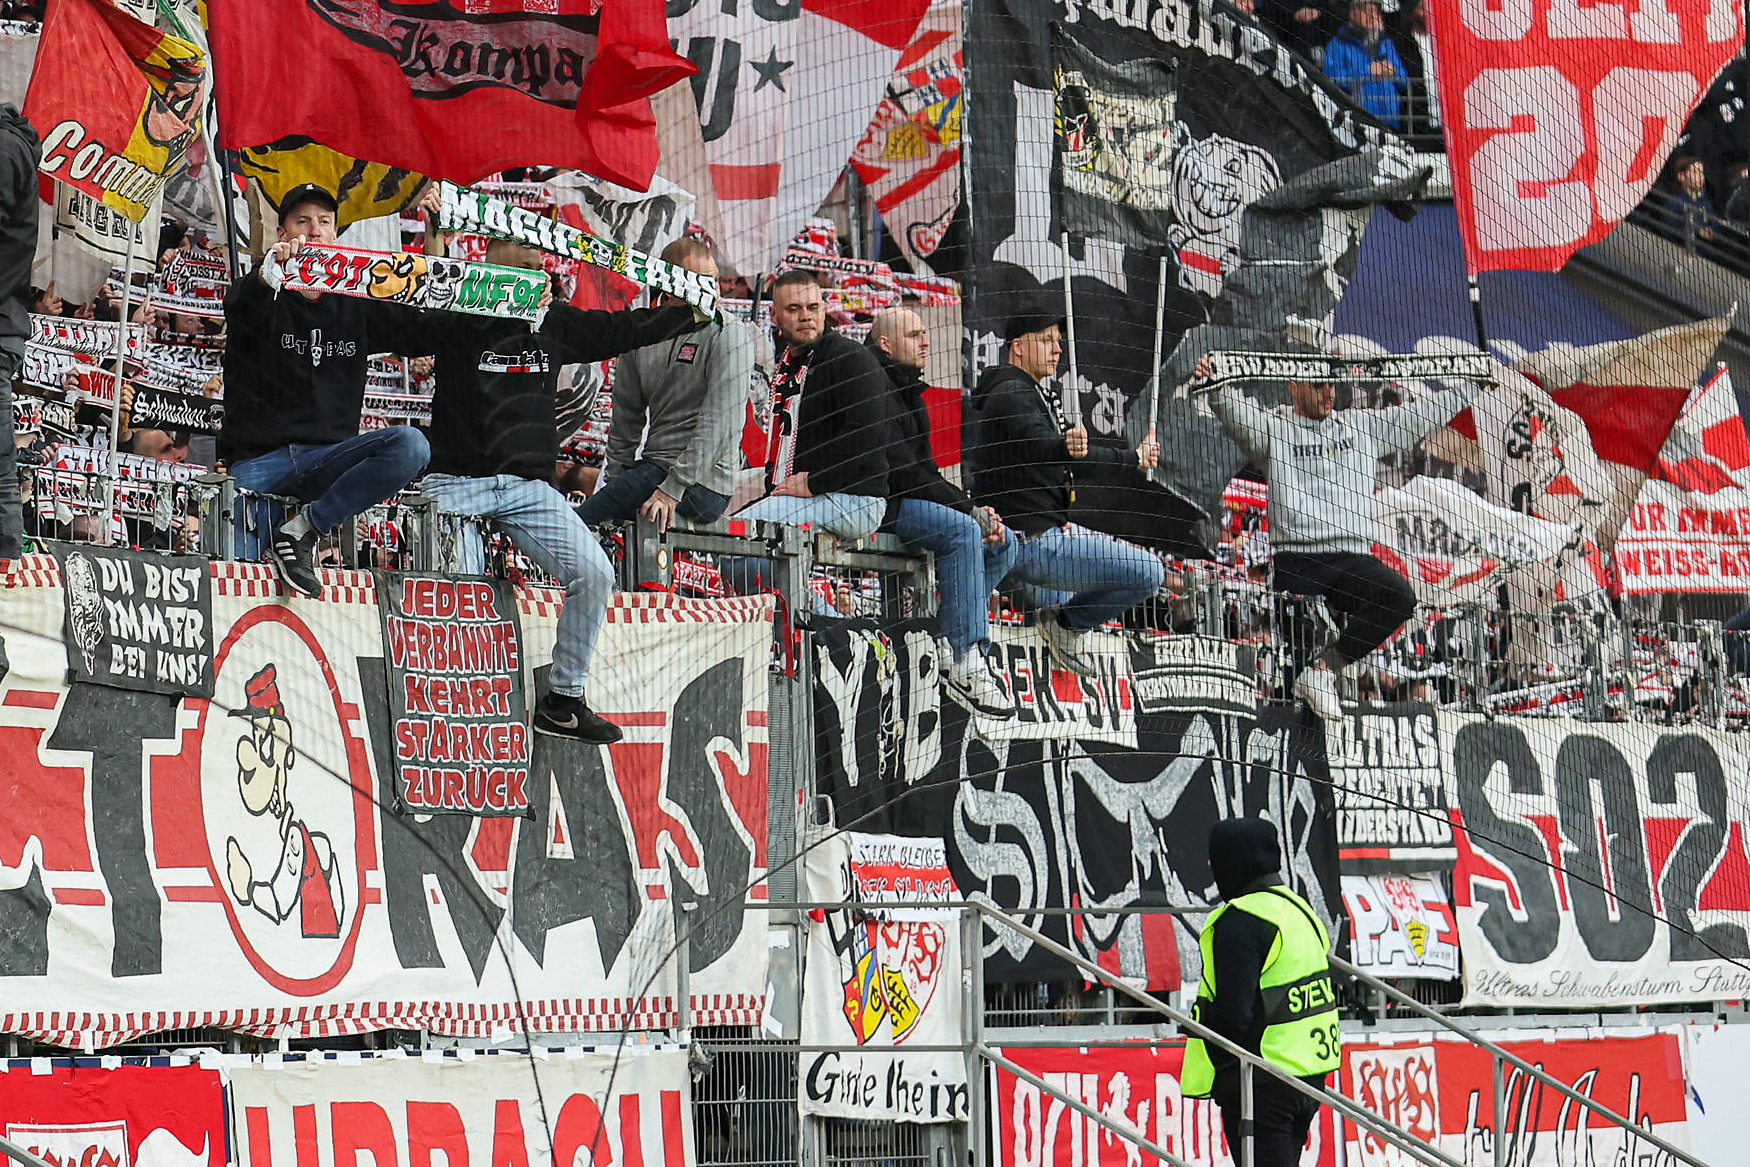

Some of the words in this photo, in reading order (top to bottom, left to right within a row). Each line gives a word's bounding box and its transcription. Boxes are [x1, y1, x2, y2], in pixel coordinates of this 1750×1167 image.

[623, 252, 718, 320] FANS
[94, 555, 135, 598] DU
[143, 562, 202, 603] BIST
[400, 577, 496, 621] JEDER
[103, 596, 207, 651] IMMER
[387, 618, 519, 673] VERBANNTE
[109, 643, 147, 677] BEI
[155, 649, 208, 686] UNS!
[404, 673, 511, 718] KEHRT
[395, 718, 528, 765] STÄRKER
[403, 763, 530, 811] ZURÜCK
[899, 845, 947, 870] BLEIBE
[1475, 967, 1539, 1000] Ultras
[1543, 966, 1685, 1000] Schwabensturm
